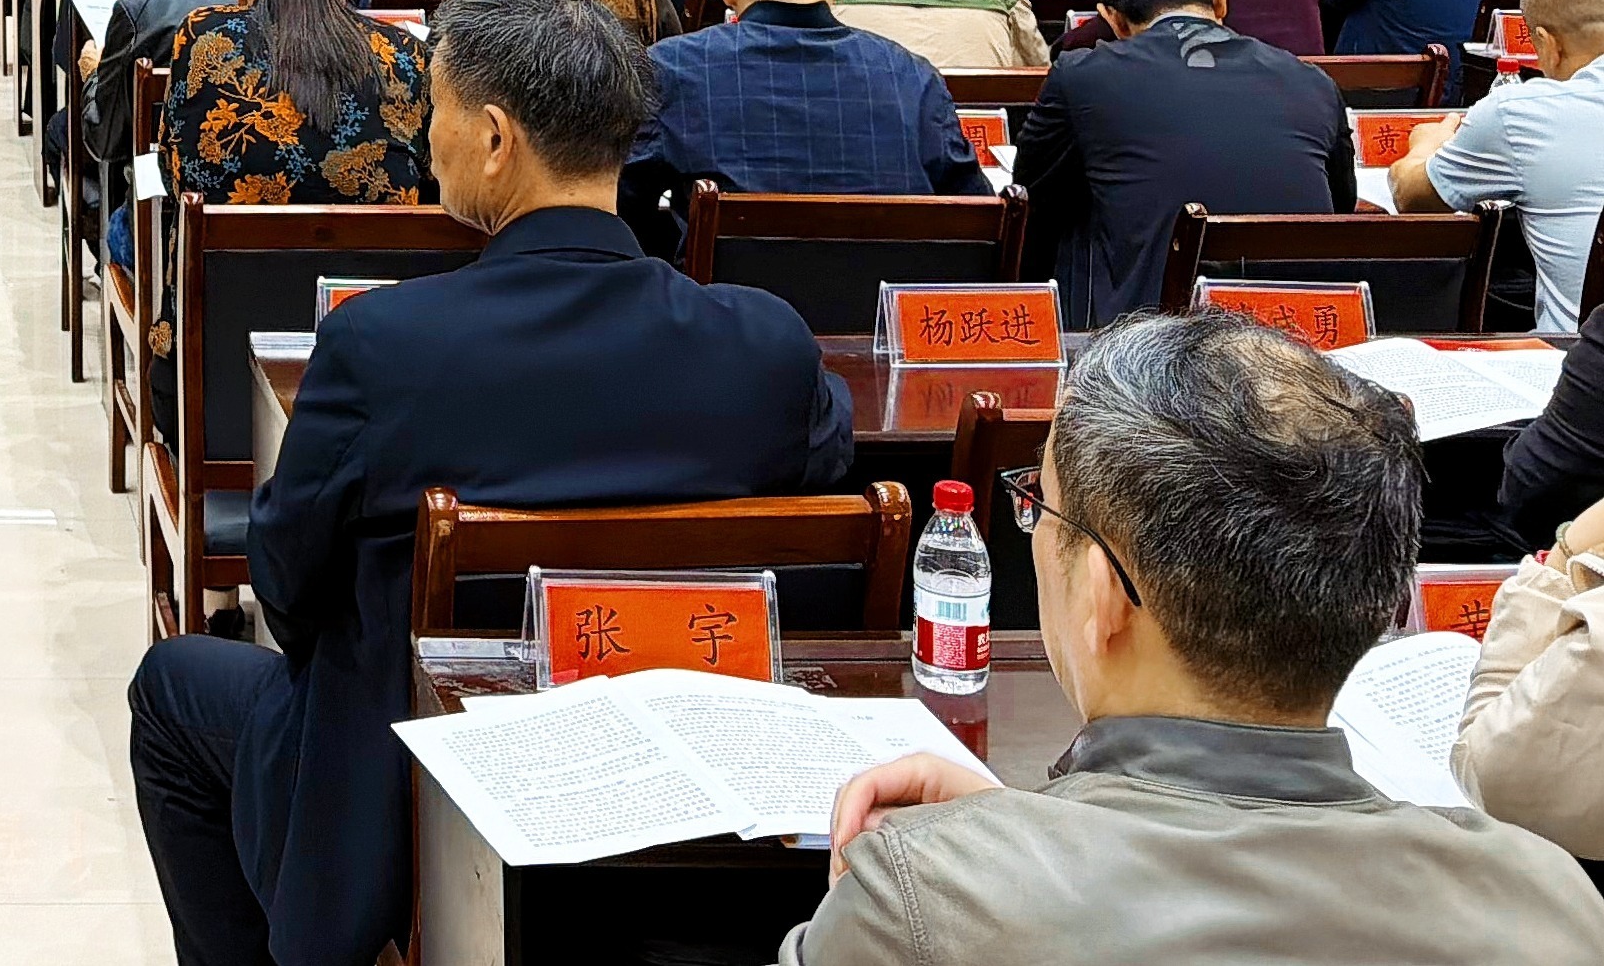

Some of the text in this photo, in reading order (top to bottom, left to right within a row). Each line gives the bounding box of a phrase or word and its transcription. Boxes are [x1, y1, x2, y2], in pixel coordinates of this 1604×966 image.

[919, 304, 1041, 346] 杨跃进
[574, 602, 739, 666] 张宇
